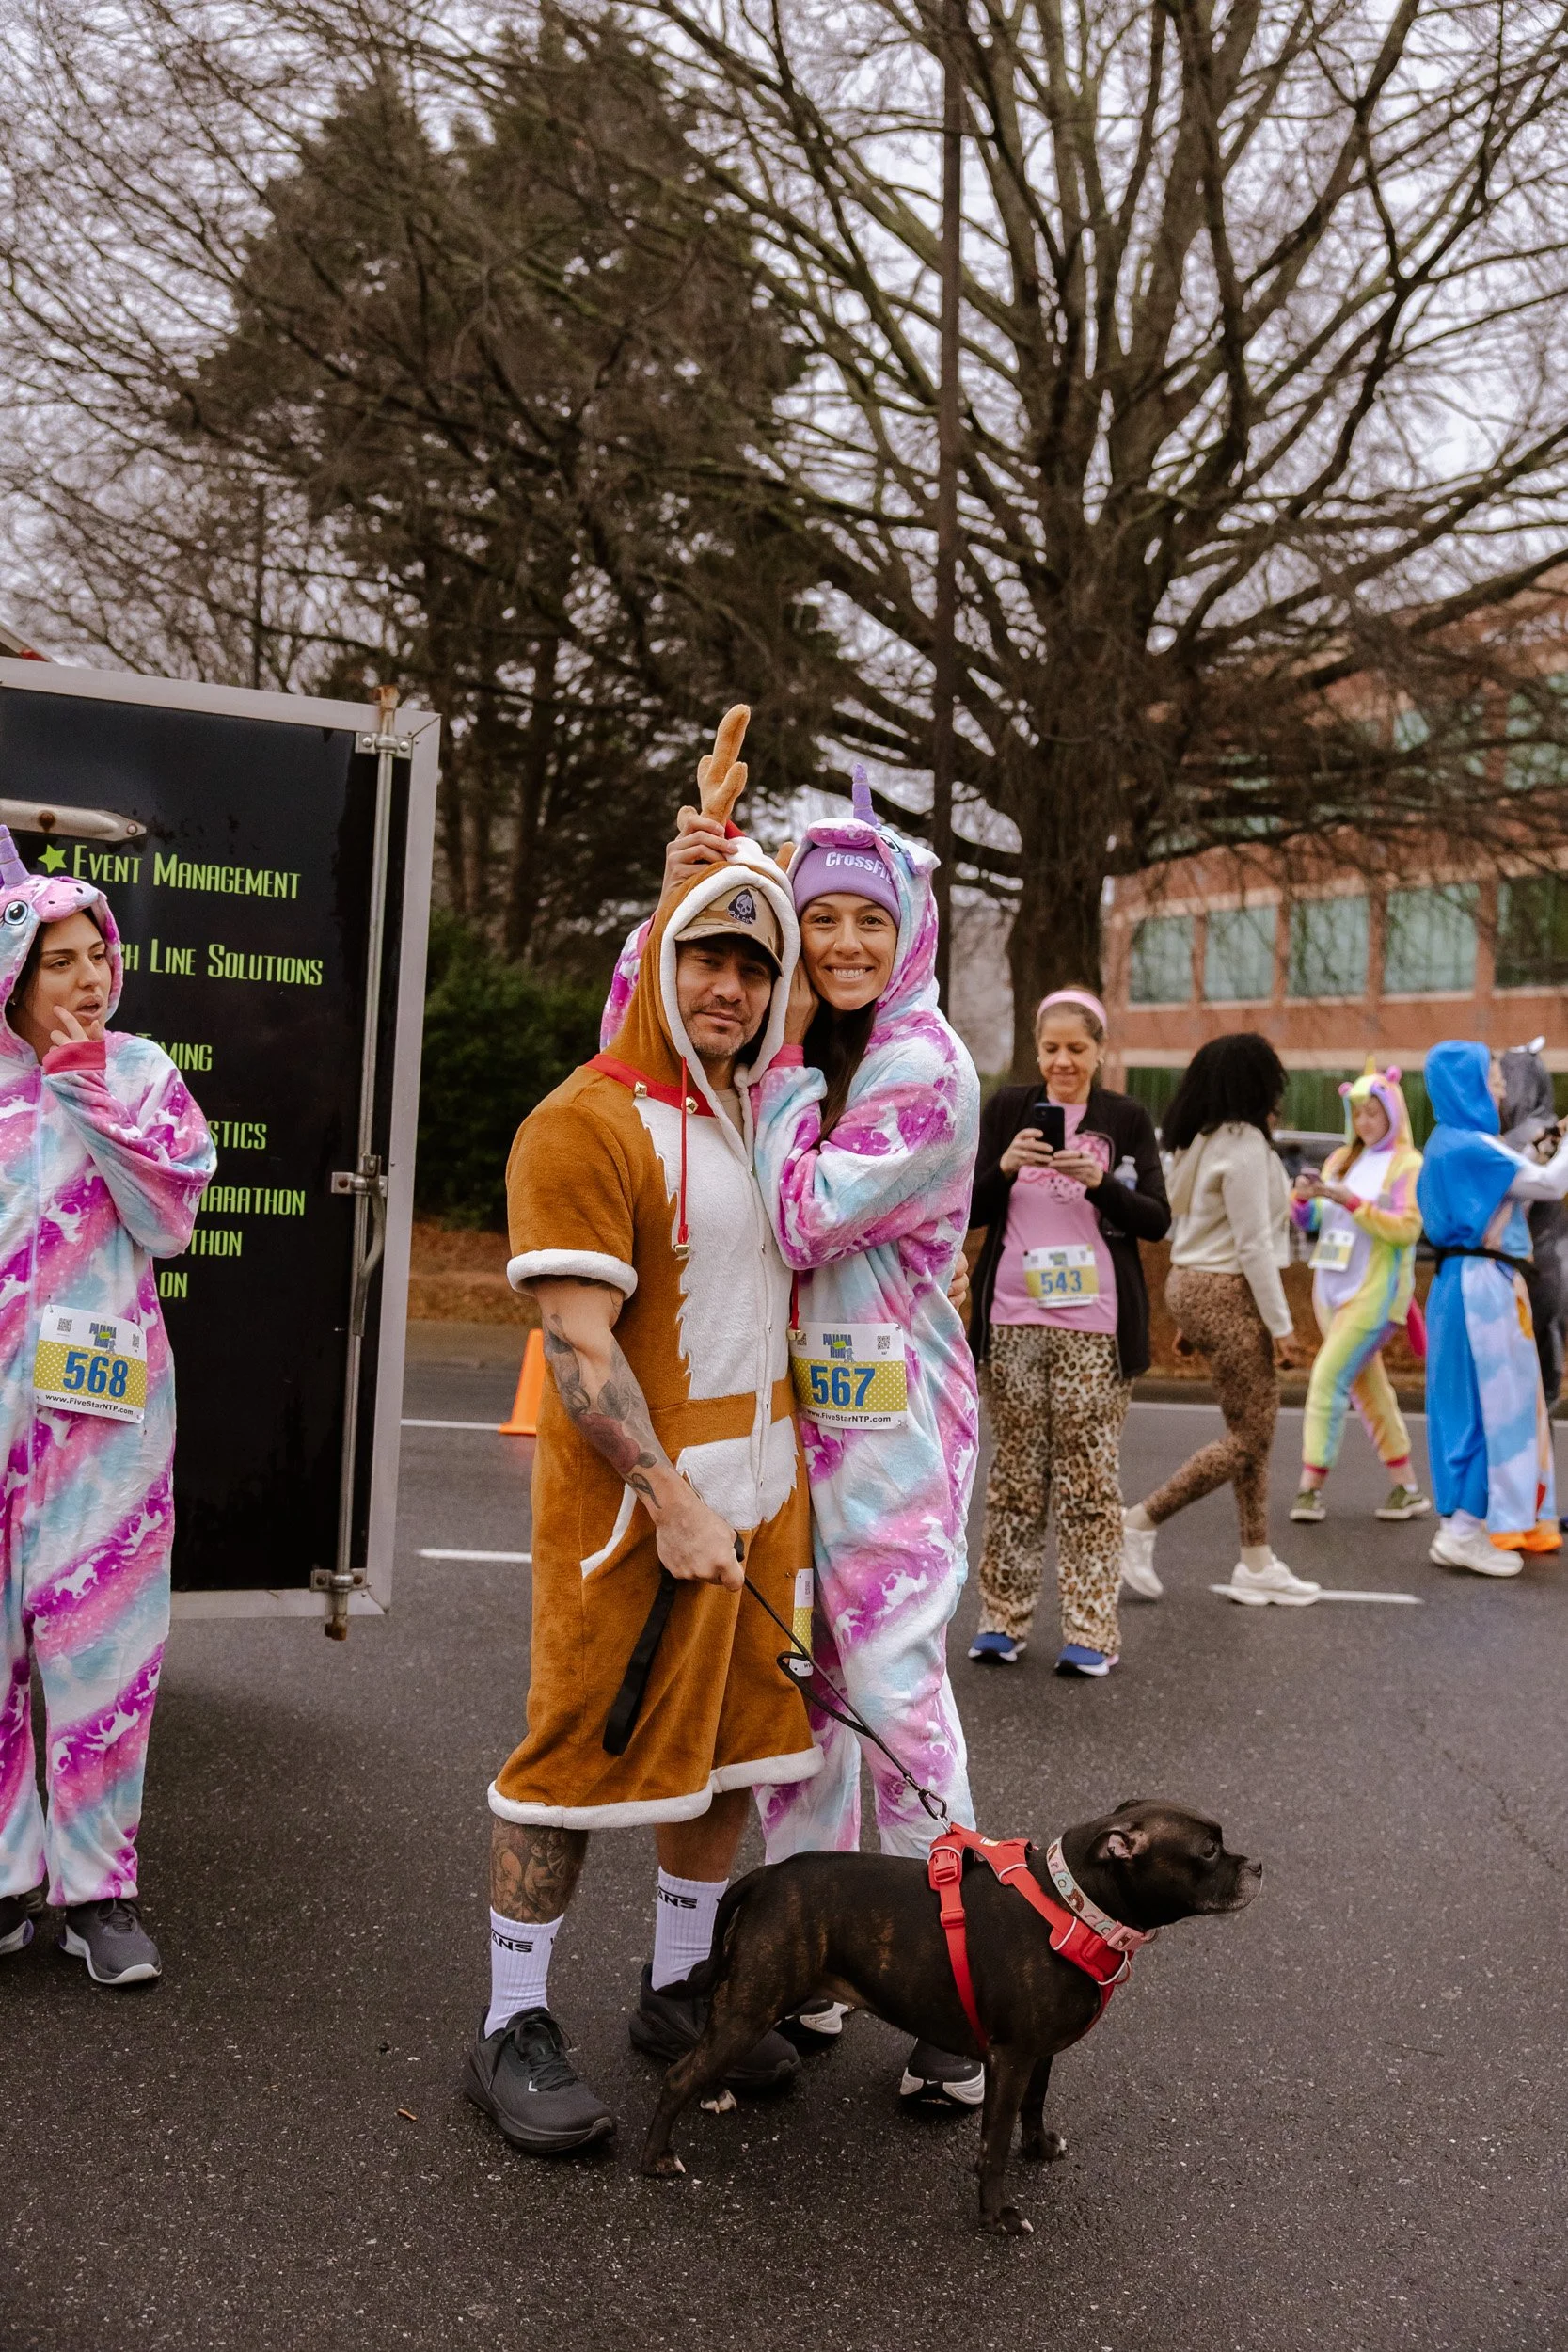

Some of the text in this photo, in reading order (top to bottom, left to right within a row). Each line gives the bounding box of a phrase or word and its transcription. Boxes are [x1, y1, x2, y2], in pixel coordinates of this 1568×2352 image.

[73, 844, 301, 899] EVENT MANAGEMENT
[150, 939, 197, 976] LINE
[207, 944, 324, 986] SOLUTIONS
[1040, 1270, 1082, 1295] 543
[63, 1351, 129, 1398] 568
[810, 1365, 876, 1407] 567
[45, 1394, 134, 1416] www.FiveStarNTP.com
[807, 1408, 891, 1422] www.FiveStarNTP.com
[658, 1886, 697, 1909] ANS
[491, 1929, 534, 1953] ANS
